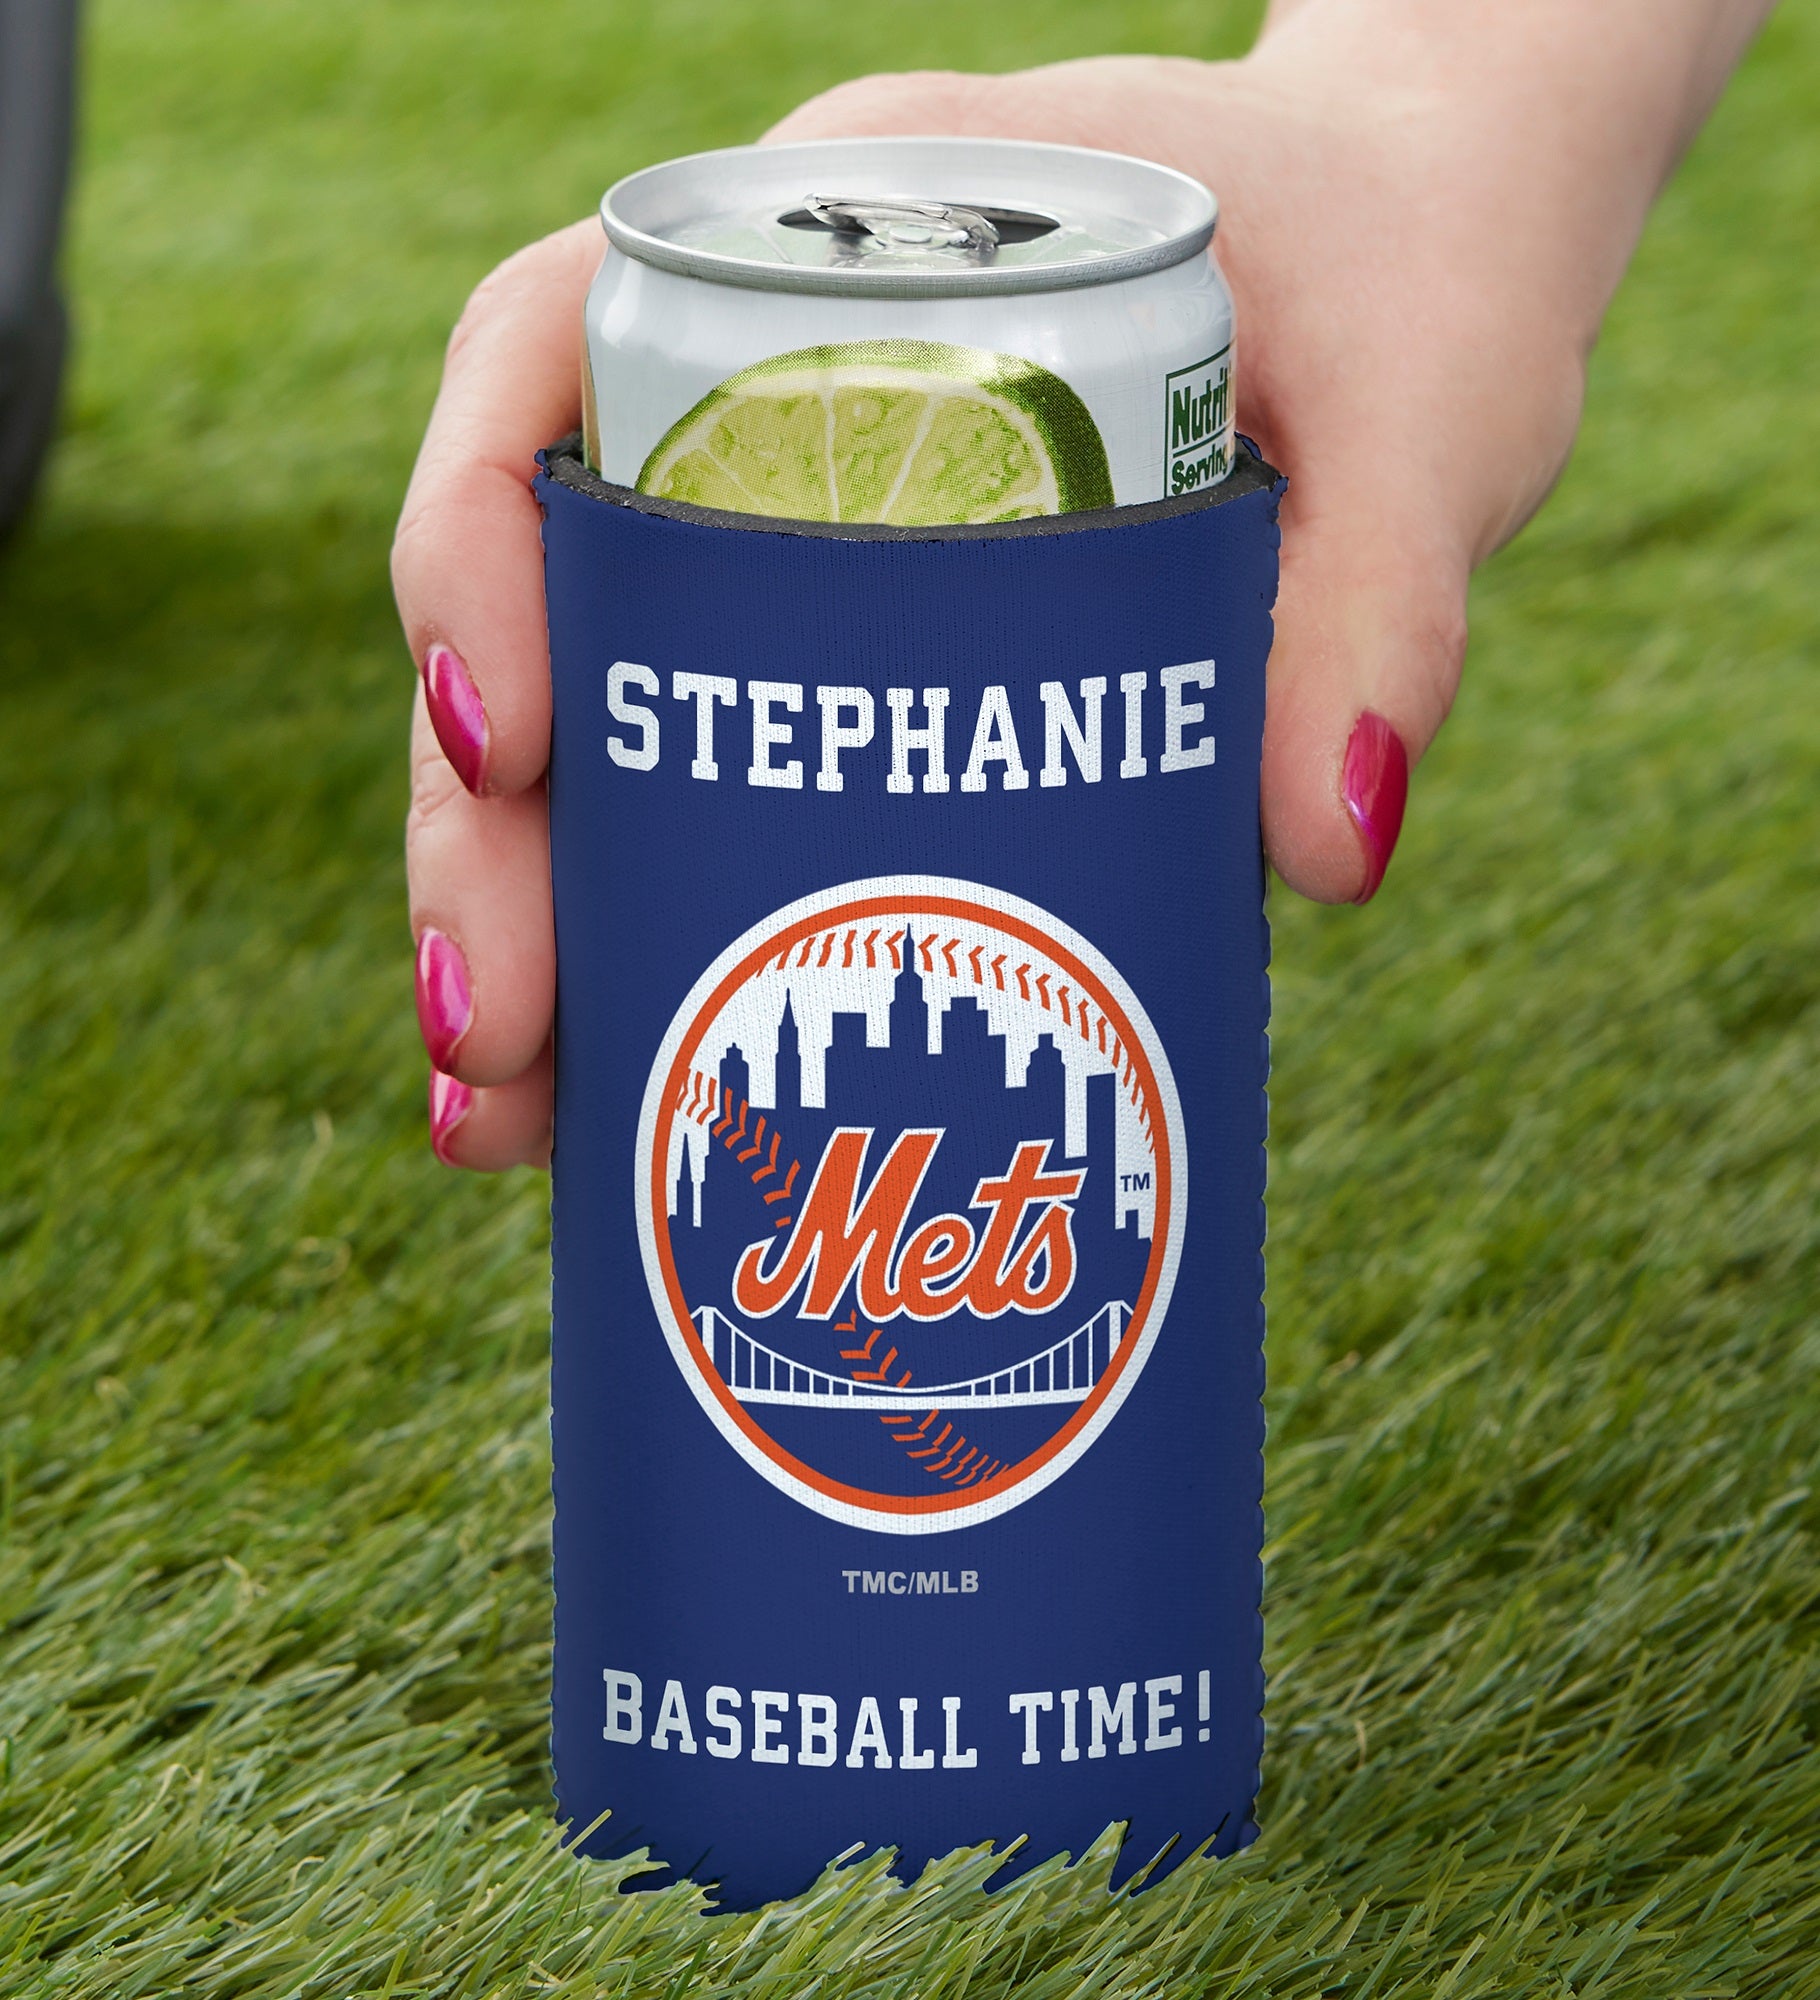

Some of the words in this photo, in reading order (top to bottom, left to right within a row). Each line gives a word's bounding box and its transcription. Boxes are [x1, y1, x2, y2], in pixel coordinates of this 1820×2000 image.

[606, 660, 1216, 794] STEPHANIE
[732, 1127, 1088, 1323] Mets
[1120, 1172, 1150, 1192] TM
[841, 1570, 980, 1595] TMC/MLB
[602, 1668, 978, 1770] BASEBALL
[1008, 1669, 1212, 1765] TIME!
